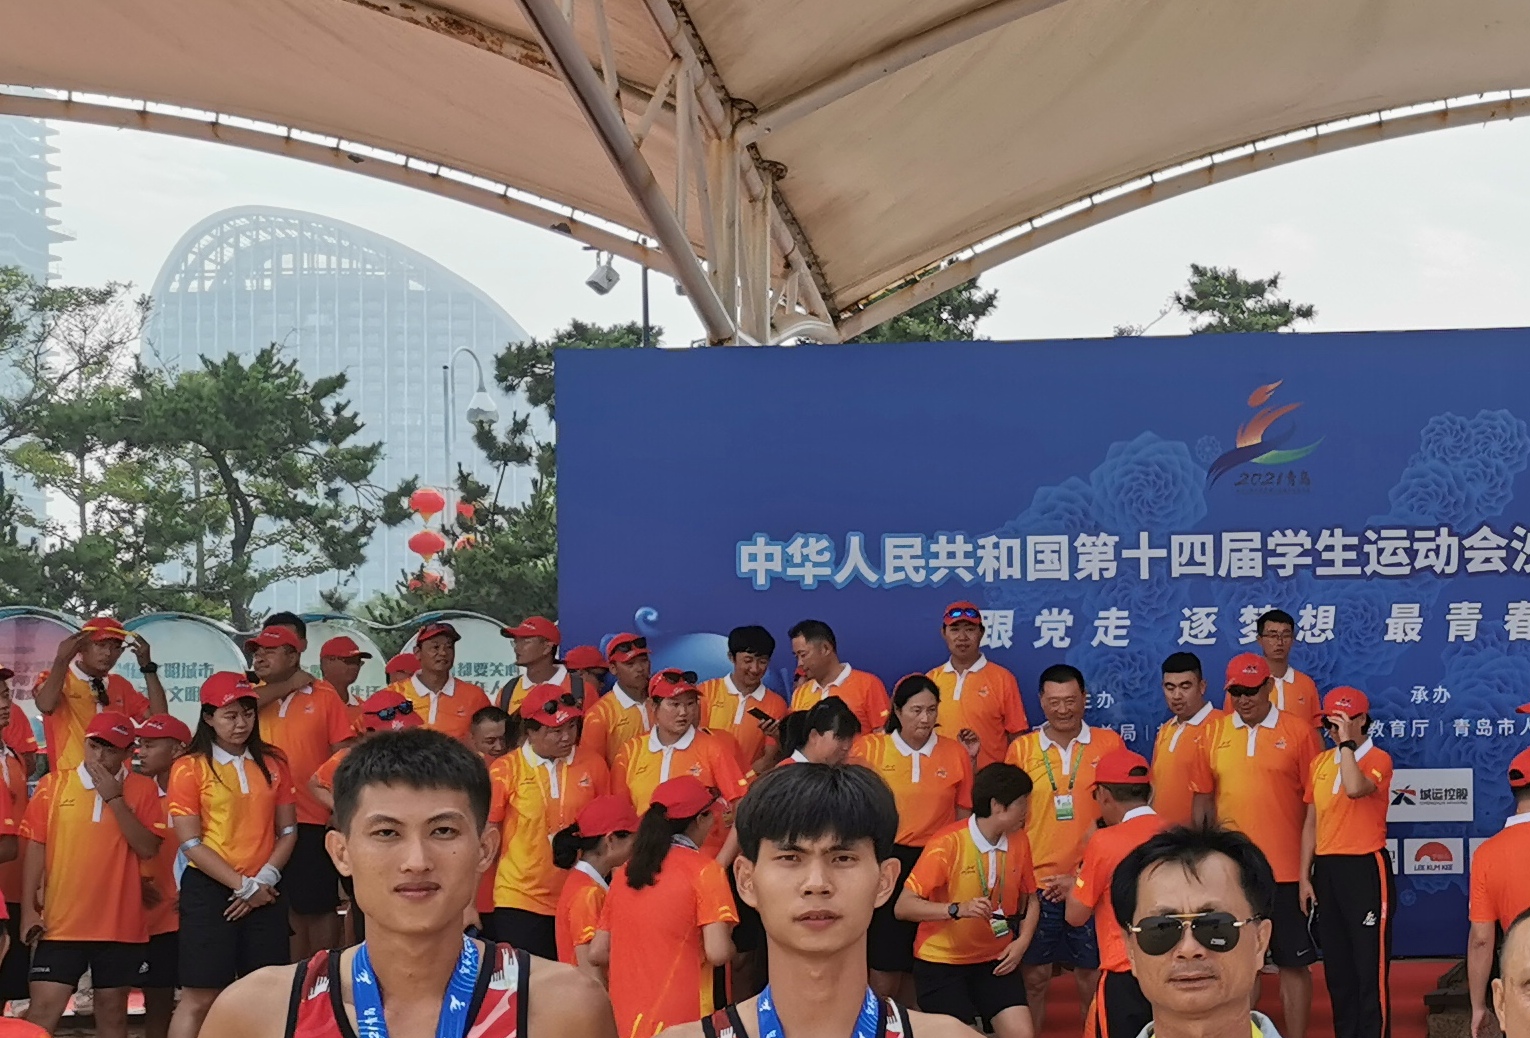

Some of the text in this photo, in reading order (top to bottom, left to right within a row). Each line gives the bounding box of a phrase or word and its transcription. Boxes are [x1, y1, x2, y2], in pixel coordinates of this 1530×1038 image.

[1411, 685, 1451, 704] 承办
[1420, 788, 1468, 800] 城运控股
